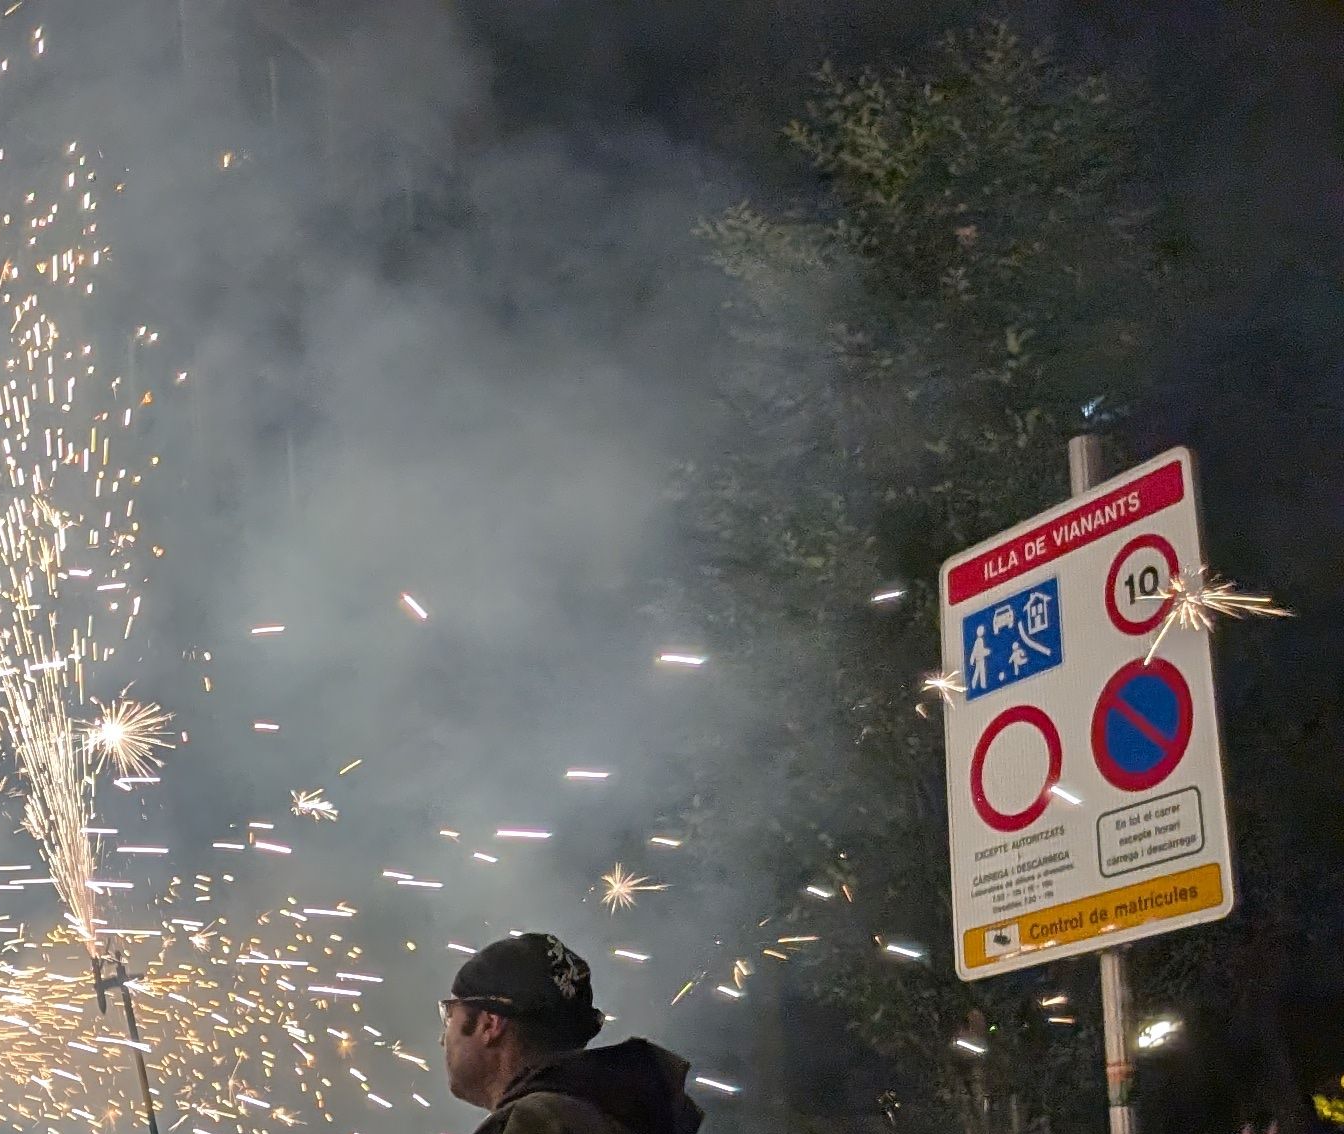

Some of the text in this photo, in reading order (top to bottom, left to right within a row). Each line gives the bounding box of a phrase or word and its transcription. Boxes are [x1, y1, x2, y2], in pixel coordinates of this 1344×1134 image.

[983, 491, 1141, 582] ILLA DE VIANANTS
[1124, 565, 1160, 605] 10
[974, 825, 1065, 862] EXCEPTE AUTORITZATS
[1029, 911, 1083, 940] Control
[1089, 908, 1108, 924] de
